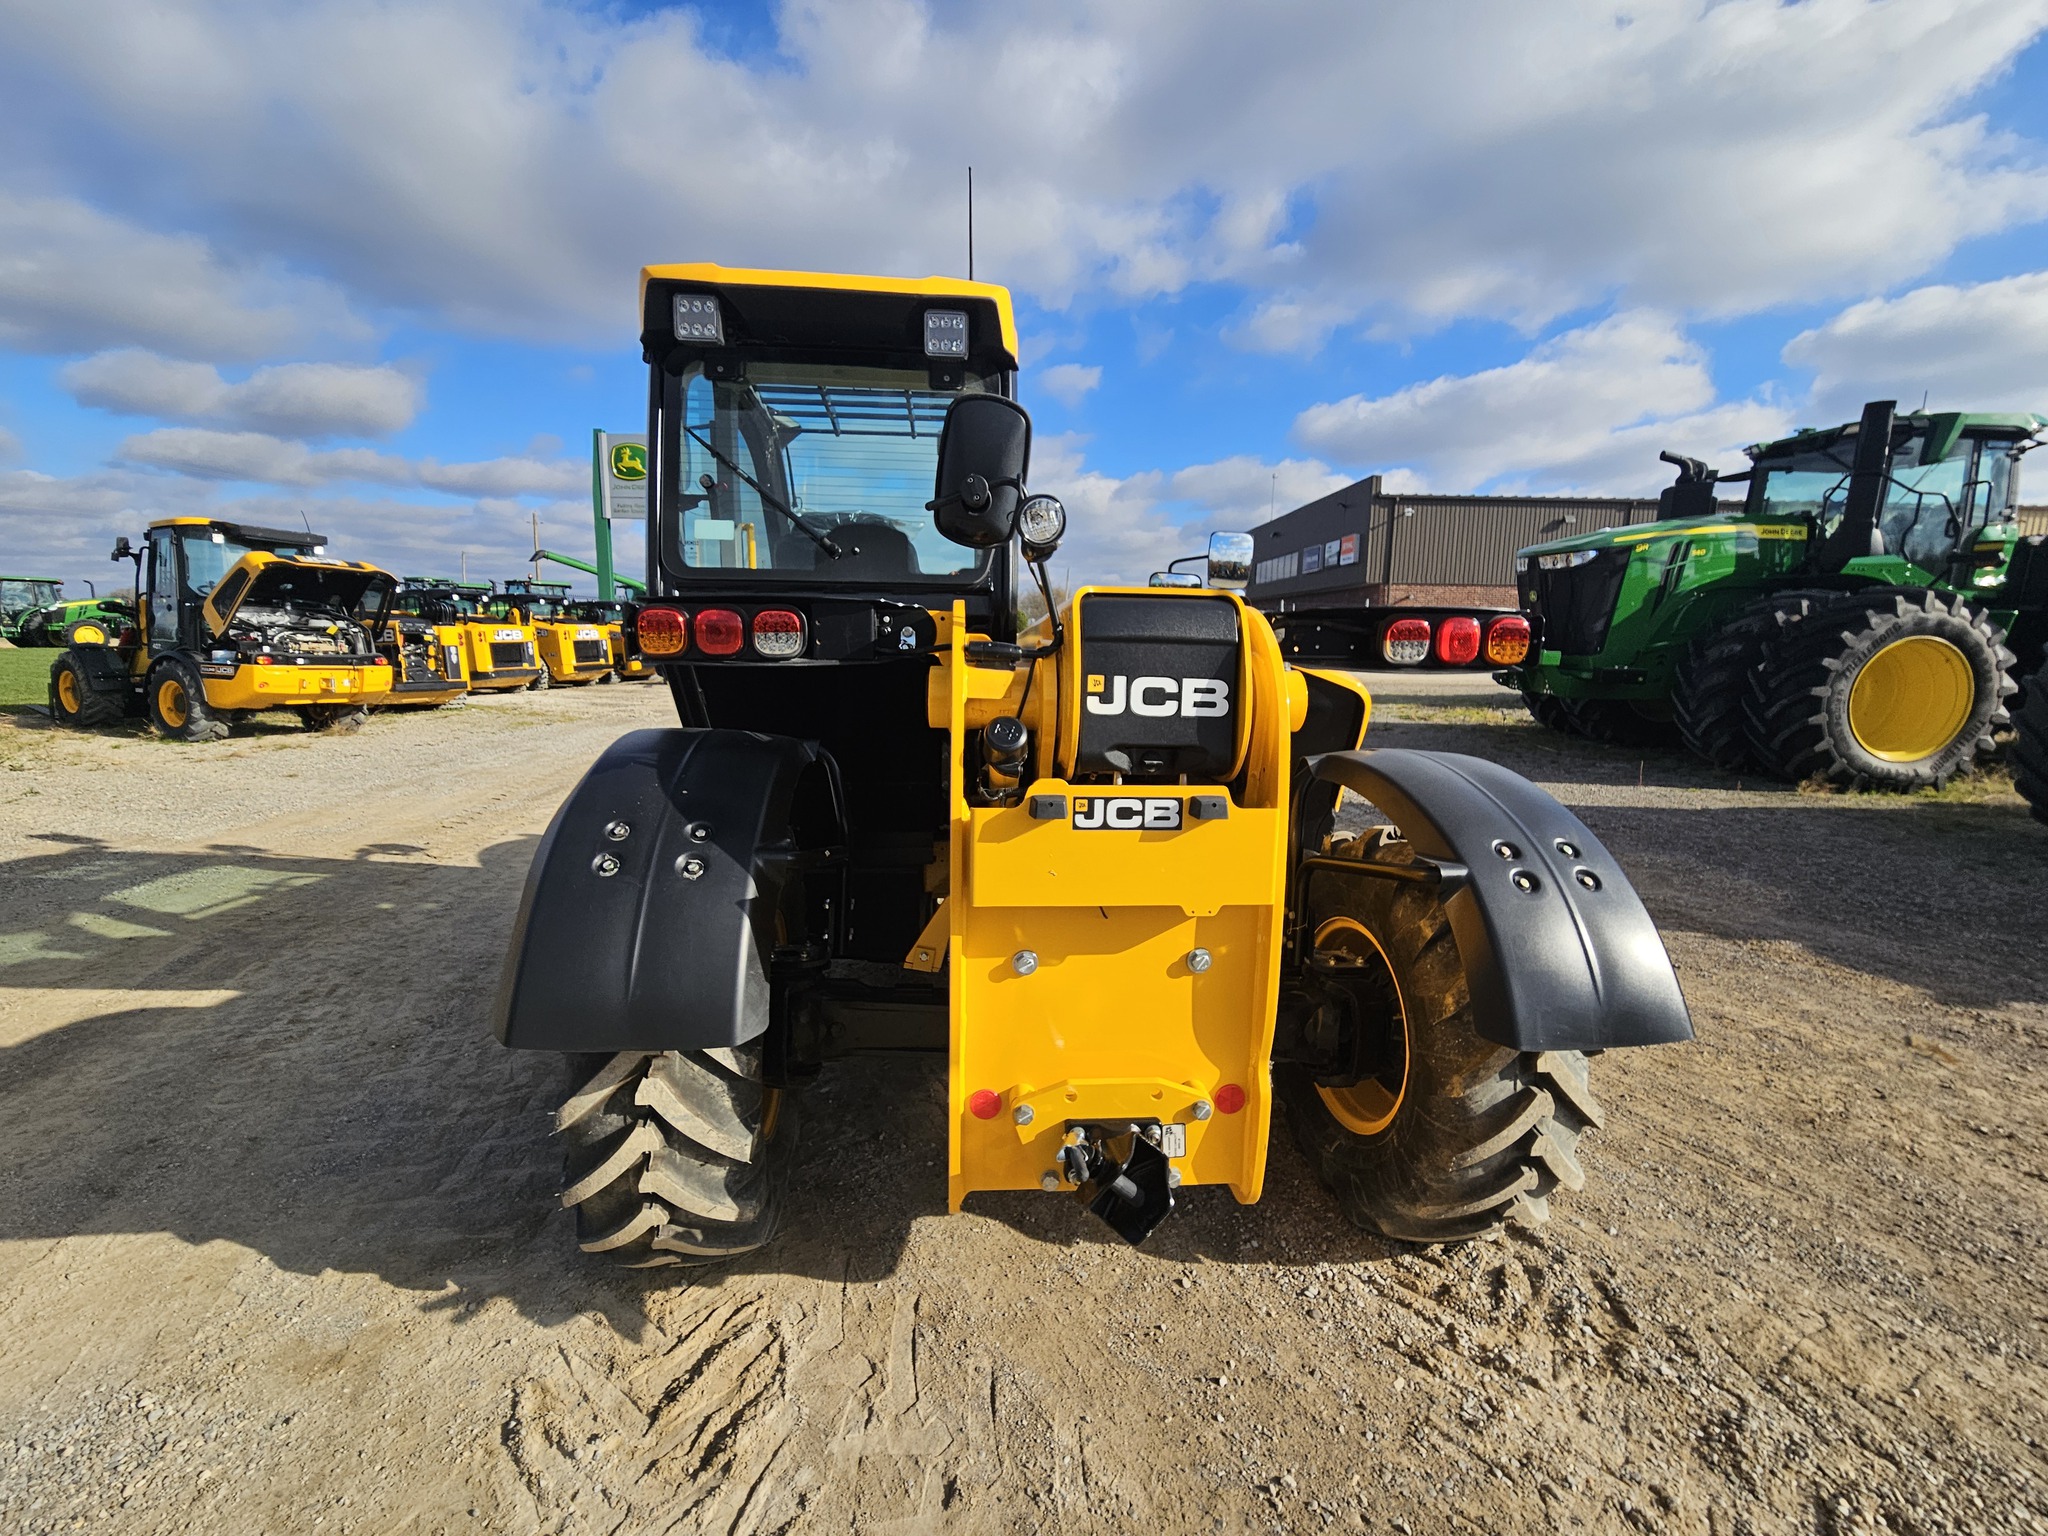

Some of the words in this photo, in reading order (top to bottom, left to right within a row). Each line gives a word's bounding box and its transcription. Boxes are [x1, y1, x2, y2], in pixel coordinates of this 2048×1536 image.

[1760, 527, 1780, 535] JOHN
[493, 630, 523, 640] JCB
[576, 629, 599, 639] JCB
[1086, 675, 1229, 717] JCB
[1074, 799, 1180, 828] JCB
